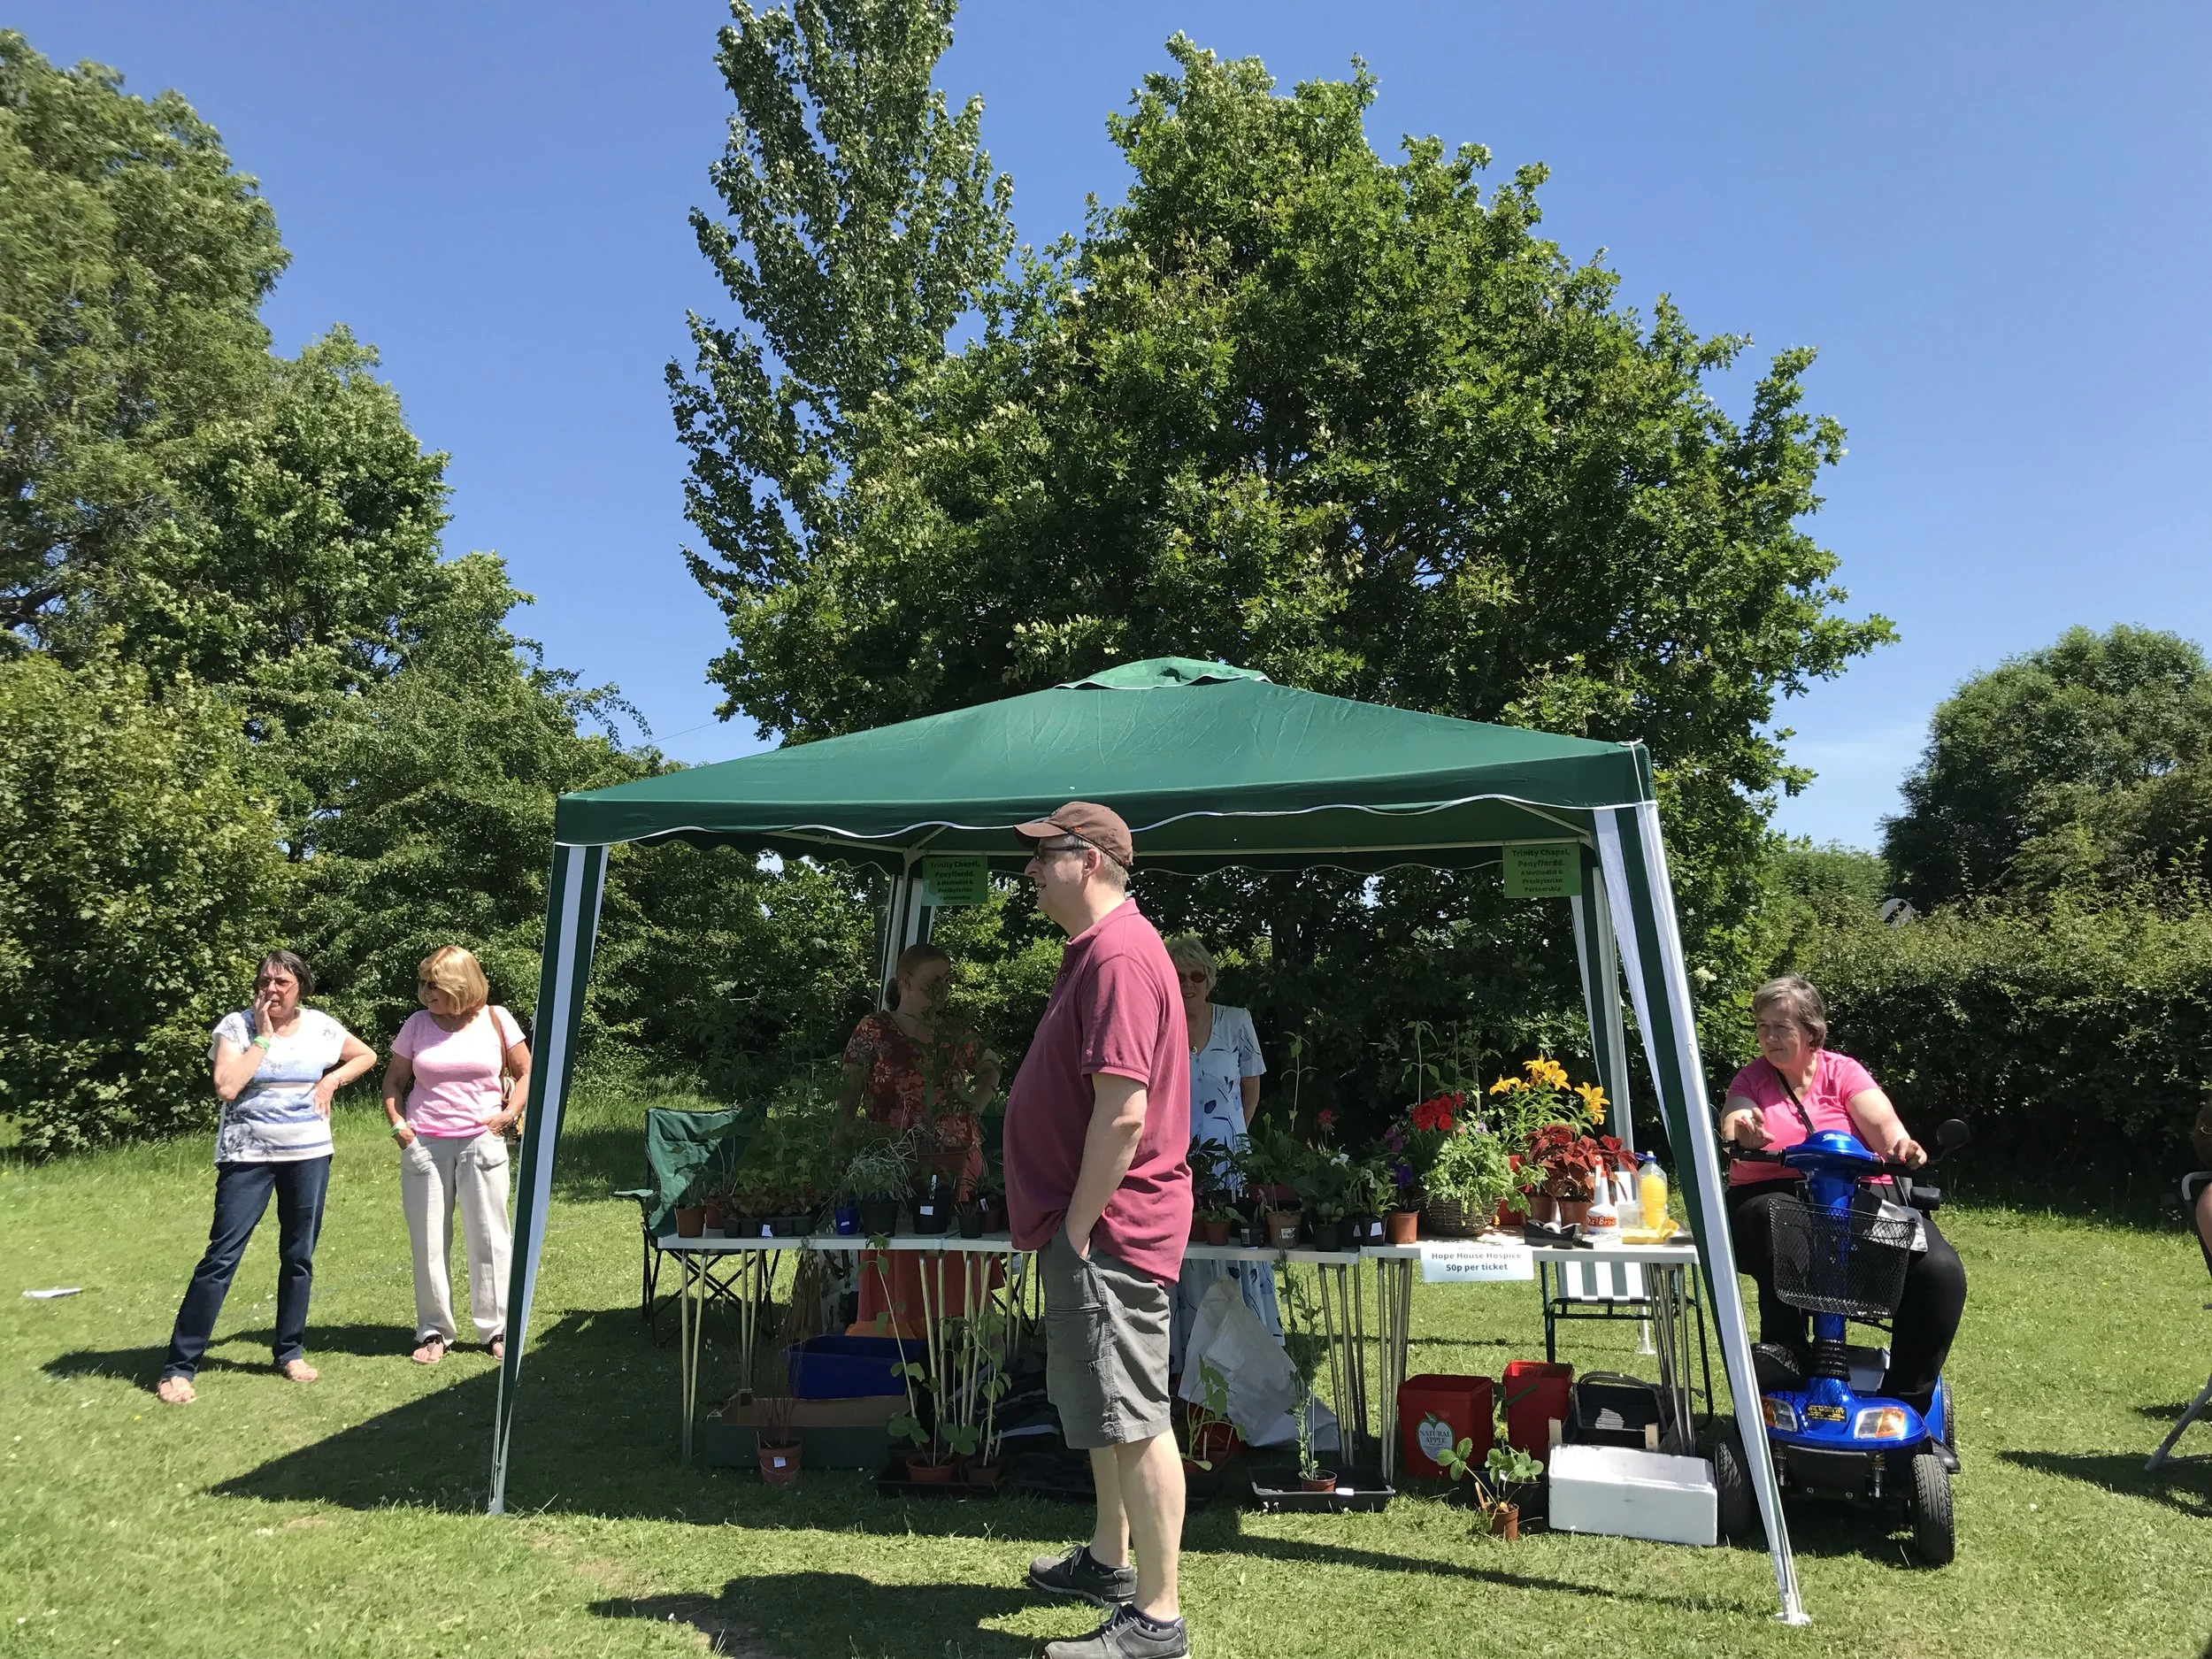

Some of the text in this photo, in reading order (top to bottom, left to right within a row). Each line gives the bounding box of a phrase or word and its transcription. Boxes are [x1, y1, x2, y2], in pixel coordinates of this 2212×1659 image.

[1432, 1252, 1455, 1261] Hope
[1446, 1263, 1463, 1272] 50p
[1464, 1263, 1479, 1272] per
